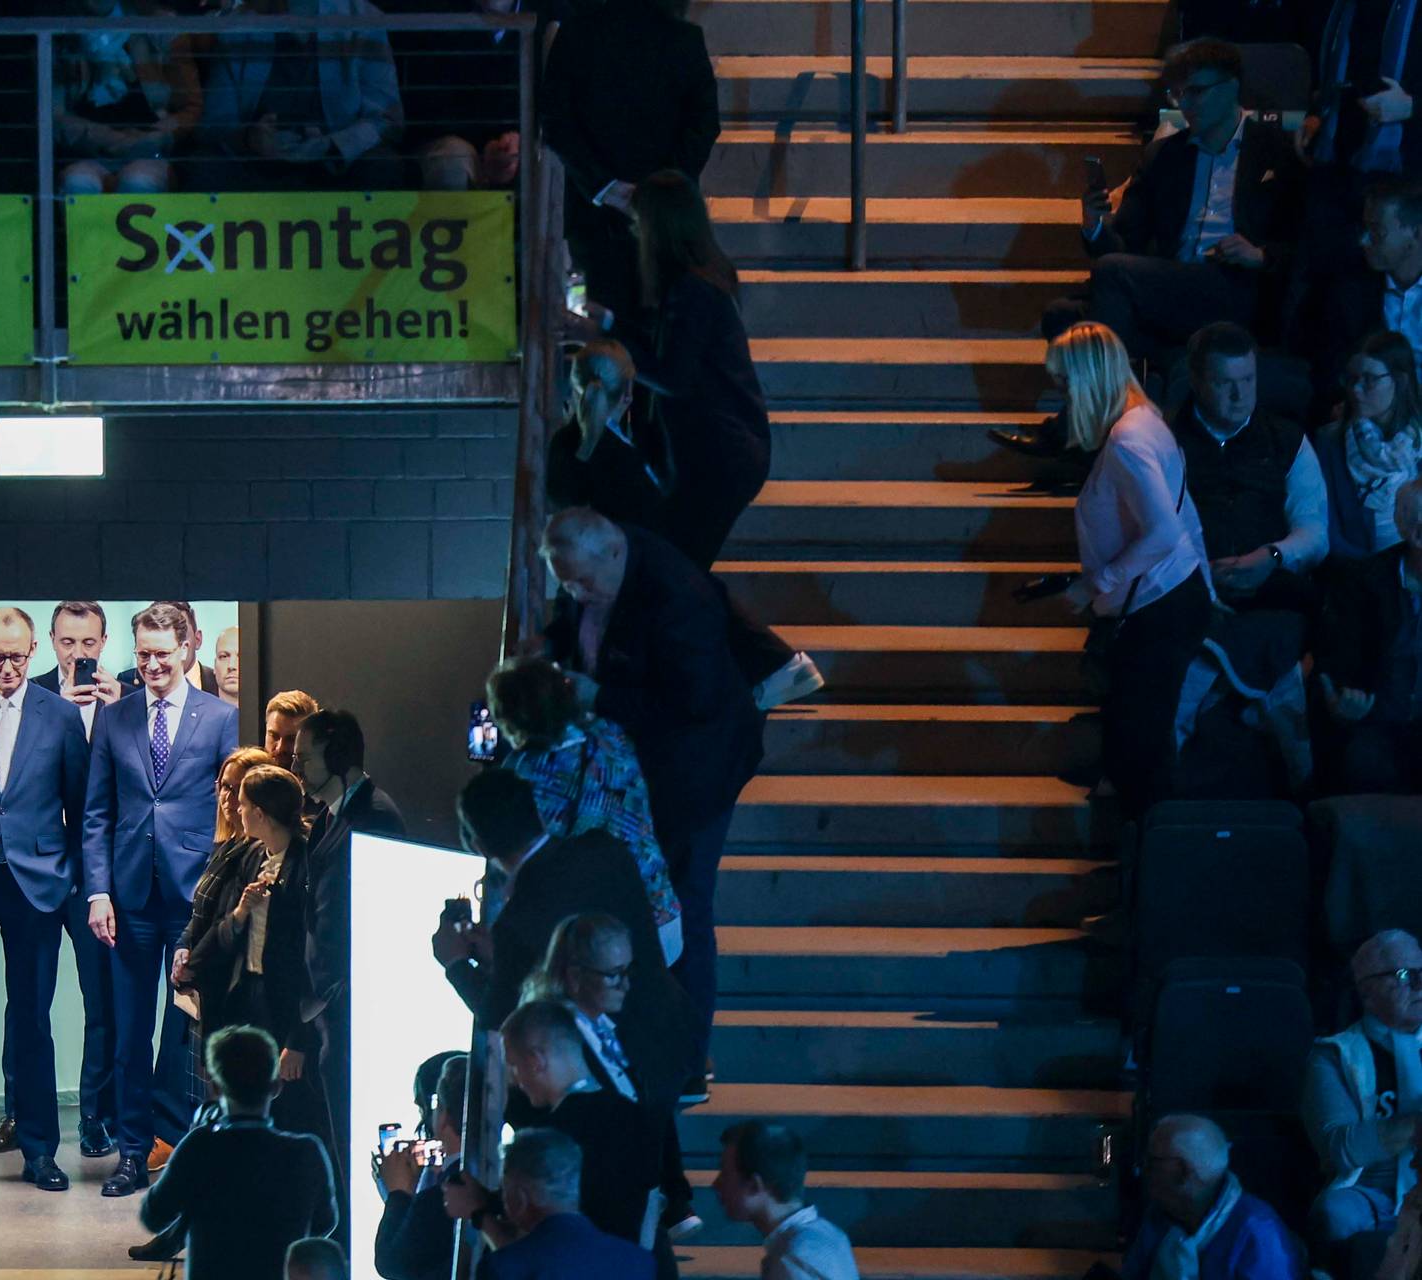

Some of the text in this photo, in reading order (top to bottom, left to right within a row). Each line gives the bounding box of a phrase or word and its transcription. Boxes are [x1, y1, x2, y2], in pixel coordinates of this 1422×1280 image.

[115, 203, 469, 292] Sonntag
[116, 298, 469, 352] wählen gehen!
